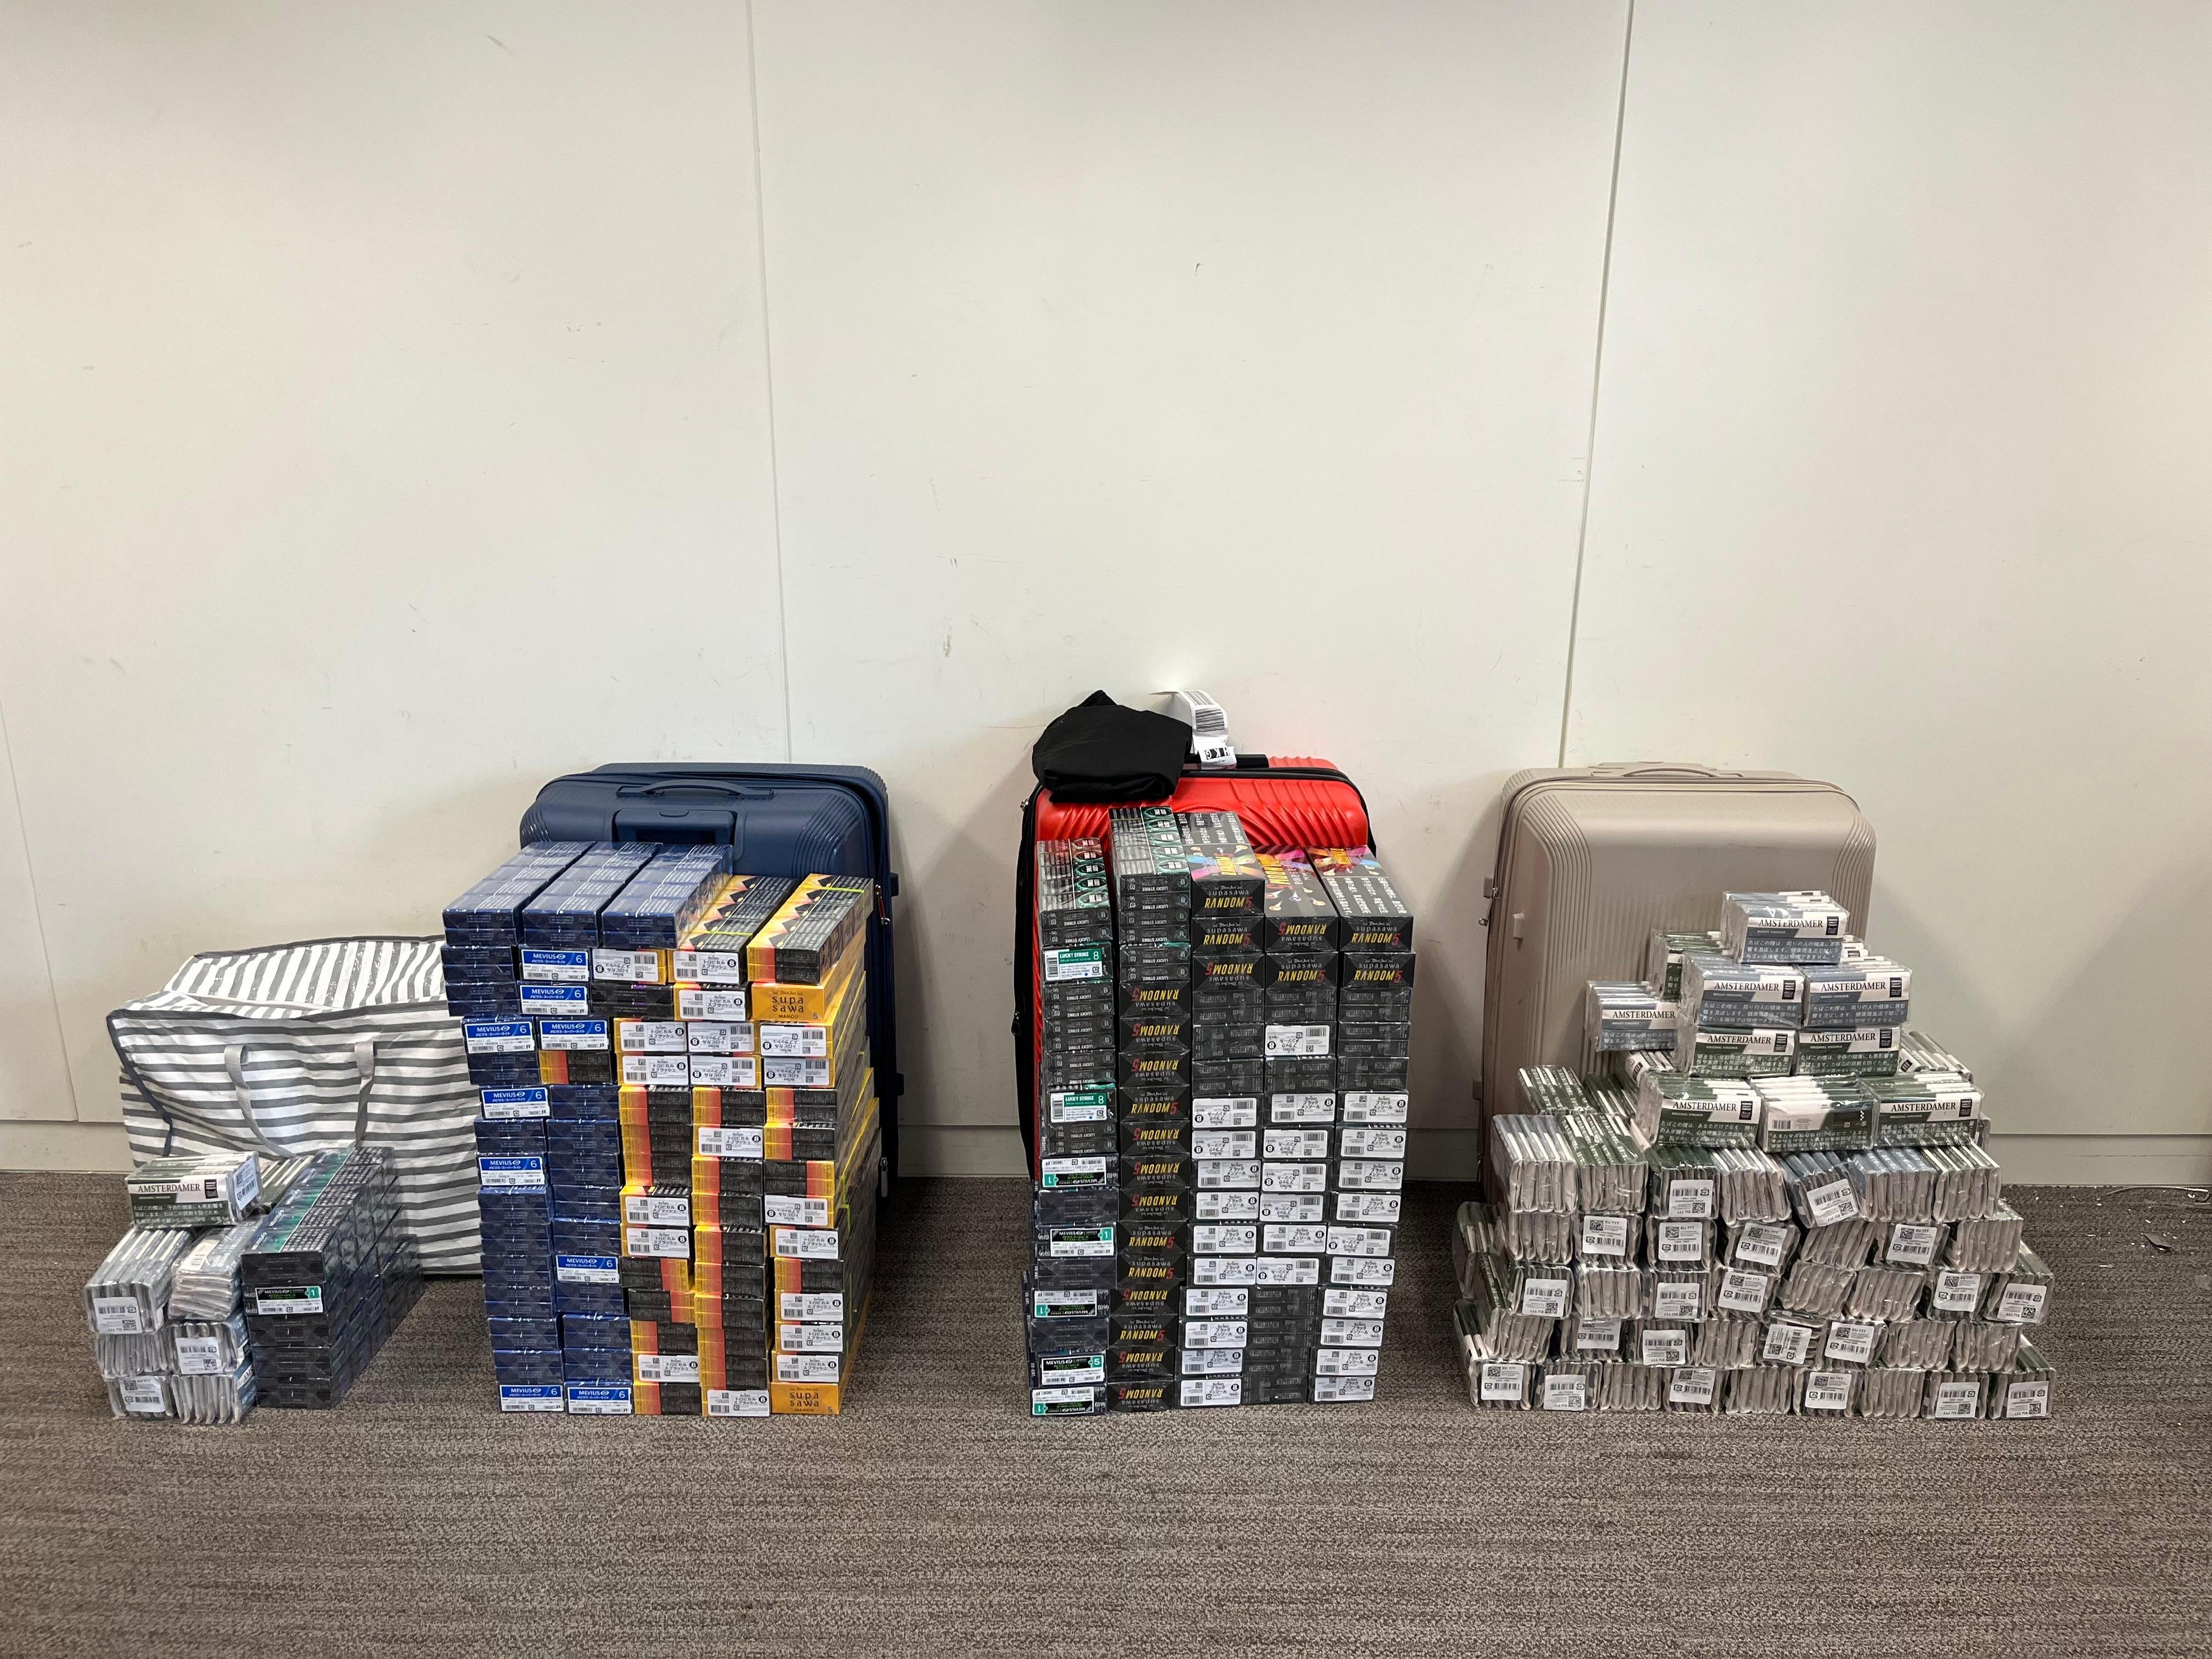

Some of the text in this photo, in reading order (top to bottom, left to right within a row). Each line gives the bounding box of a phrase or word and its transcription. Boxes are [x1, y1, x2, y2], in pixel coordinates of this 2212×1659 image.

[1759, 919, 1823, 928] AMSTERDAMER
[576, 955, 583, 963] 6
[1093, 951, 1099, 960] 8
[1714, 982, 1779, 992] AMSTERDAMER
[1821, 981, 1886, 991] AMSTERDAMER
[574, 990, 581, 998] 6
[772, 996, 804, 1005] supa
[1613, 1010, 1676, 1019] AMSTERDAMER
[519, 1025, 527, 1034] 6
[594, 1024, 602, 1032] 6
[1707, 1035, 1771, 1045] AMSTERDAMER
[1810, 1032, 1876, 1042] AMSTERDAMER
[1098, 1095, 1104, 1104] 8
[1672, 1102, 1737, 1112] AMSTERDAMER
[1891, 1102, 1956, 1112] AMSTERDAMER
[138, 1184, 201, 1193] AMSTERDAMER
[790, 1391, 819, 1401] supa
